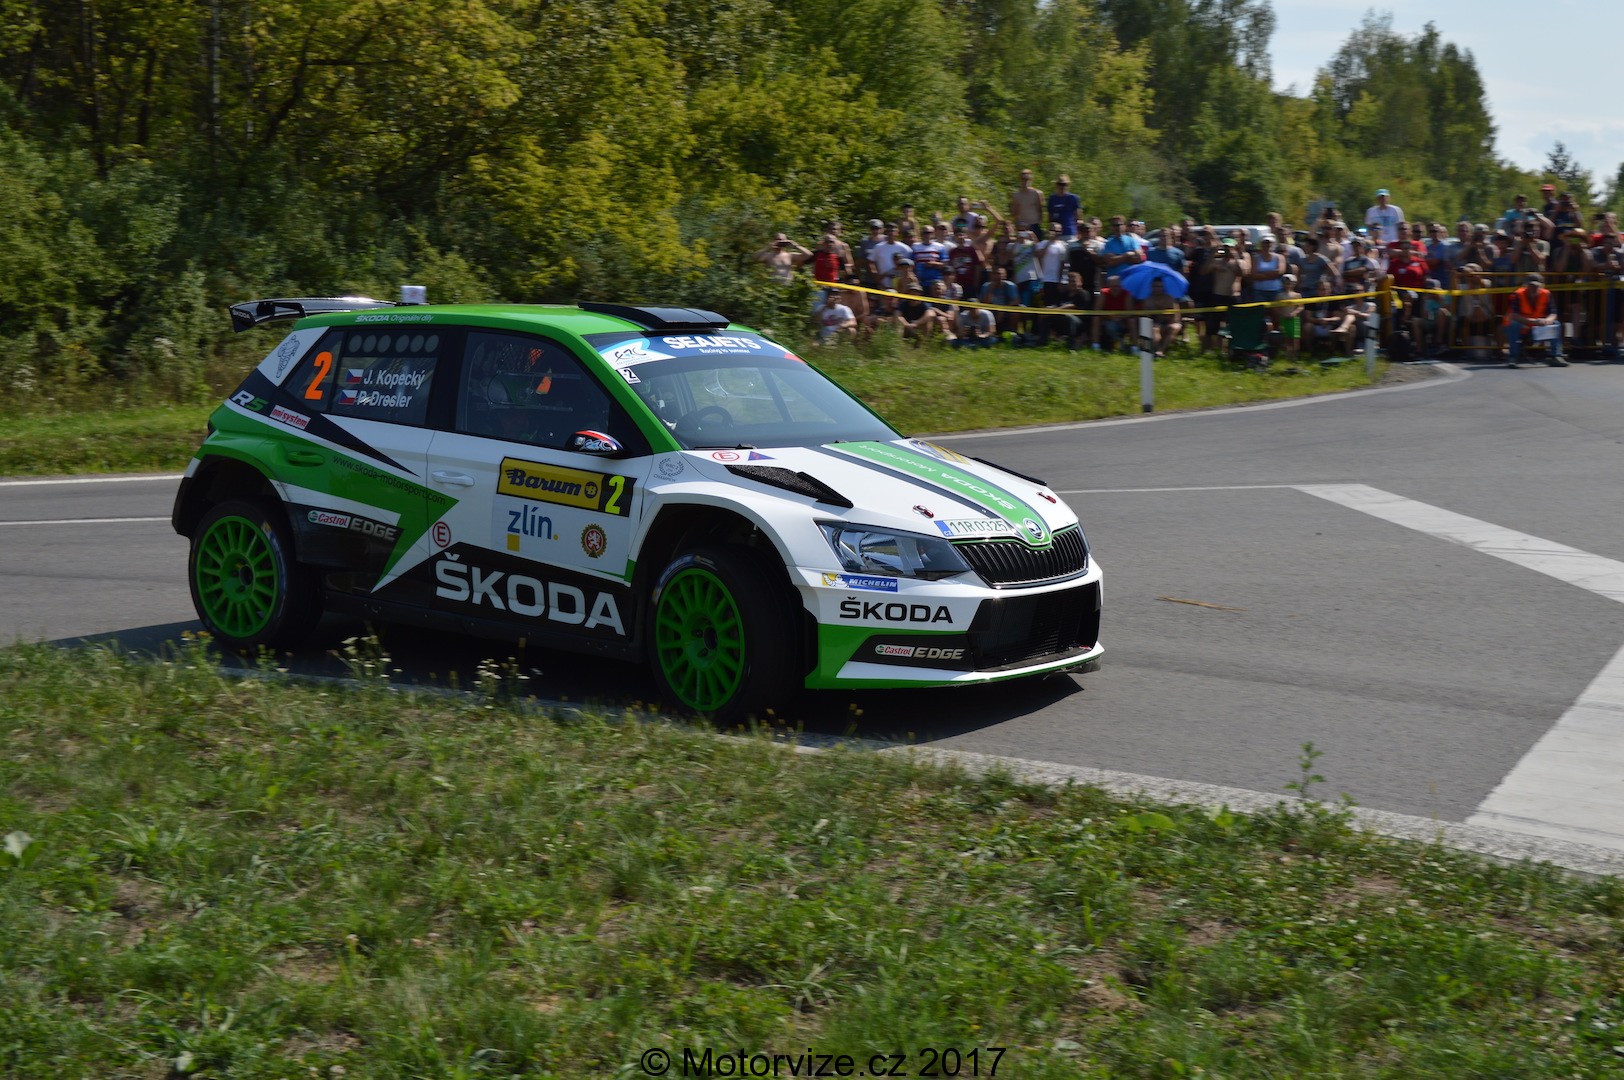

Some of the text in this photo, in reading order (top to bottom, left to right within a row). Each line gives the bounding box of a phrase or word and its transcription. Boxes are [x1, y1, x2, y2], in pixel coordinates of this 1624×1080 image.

[663, 336, 761, 349] SEAJETS
[304, 351, 333, 400] 2
[364, 370, 425, 390] J. Kopecký
[623, 369, 636, 379] 2
[369, 391, 412, 408] Dresler
[505, 468, 582, 496] Barum
[604, 475, 626, 515] 2
[940, 472, 1017, 511] ŠKODA
[317, 513, 397, 541] Castrol EDGE
[435, 551, 626, 636] ŠKODA
[849, 578, 898, 588] MICHELIN
[839, 596, 953, 624] ŠKODA
[884, 646, 965, 660] Castrol EDGE
